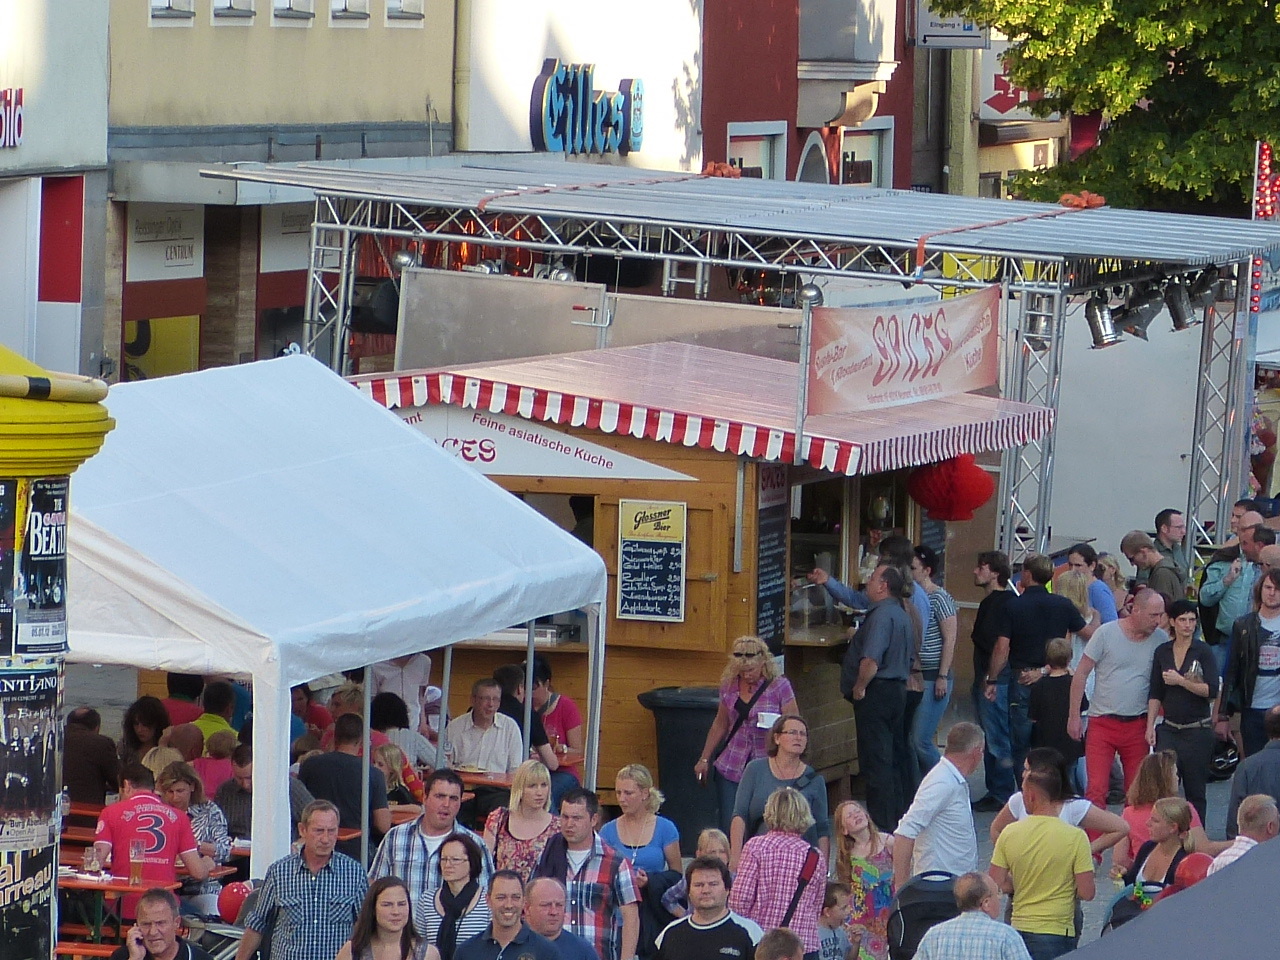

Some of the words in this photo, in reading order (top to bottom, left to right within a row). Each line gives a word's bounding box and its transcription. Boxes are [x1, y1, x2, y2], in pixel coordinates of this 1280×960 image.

[472, 412, 506, 433] Feine
[508, 426, 572, 455] asiatische
[573, 446, 614, 470] Küche
[653, 521, 671, 531] Bier
[134, 813, 167, 855] 3
